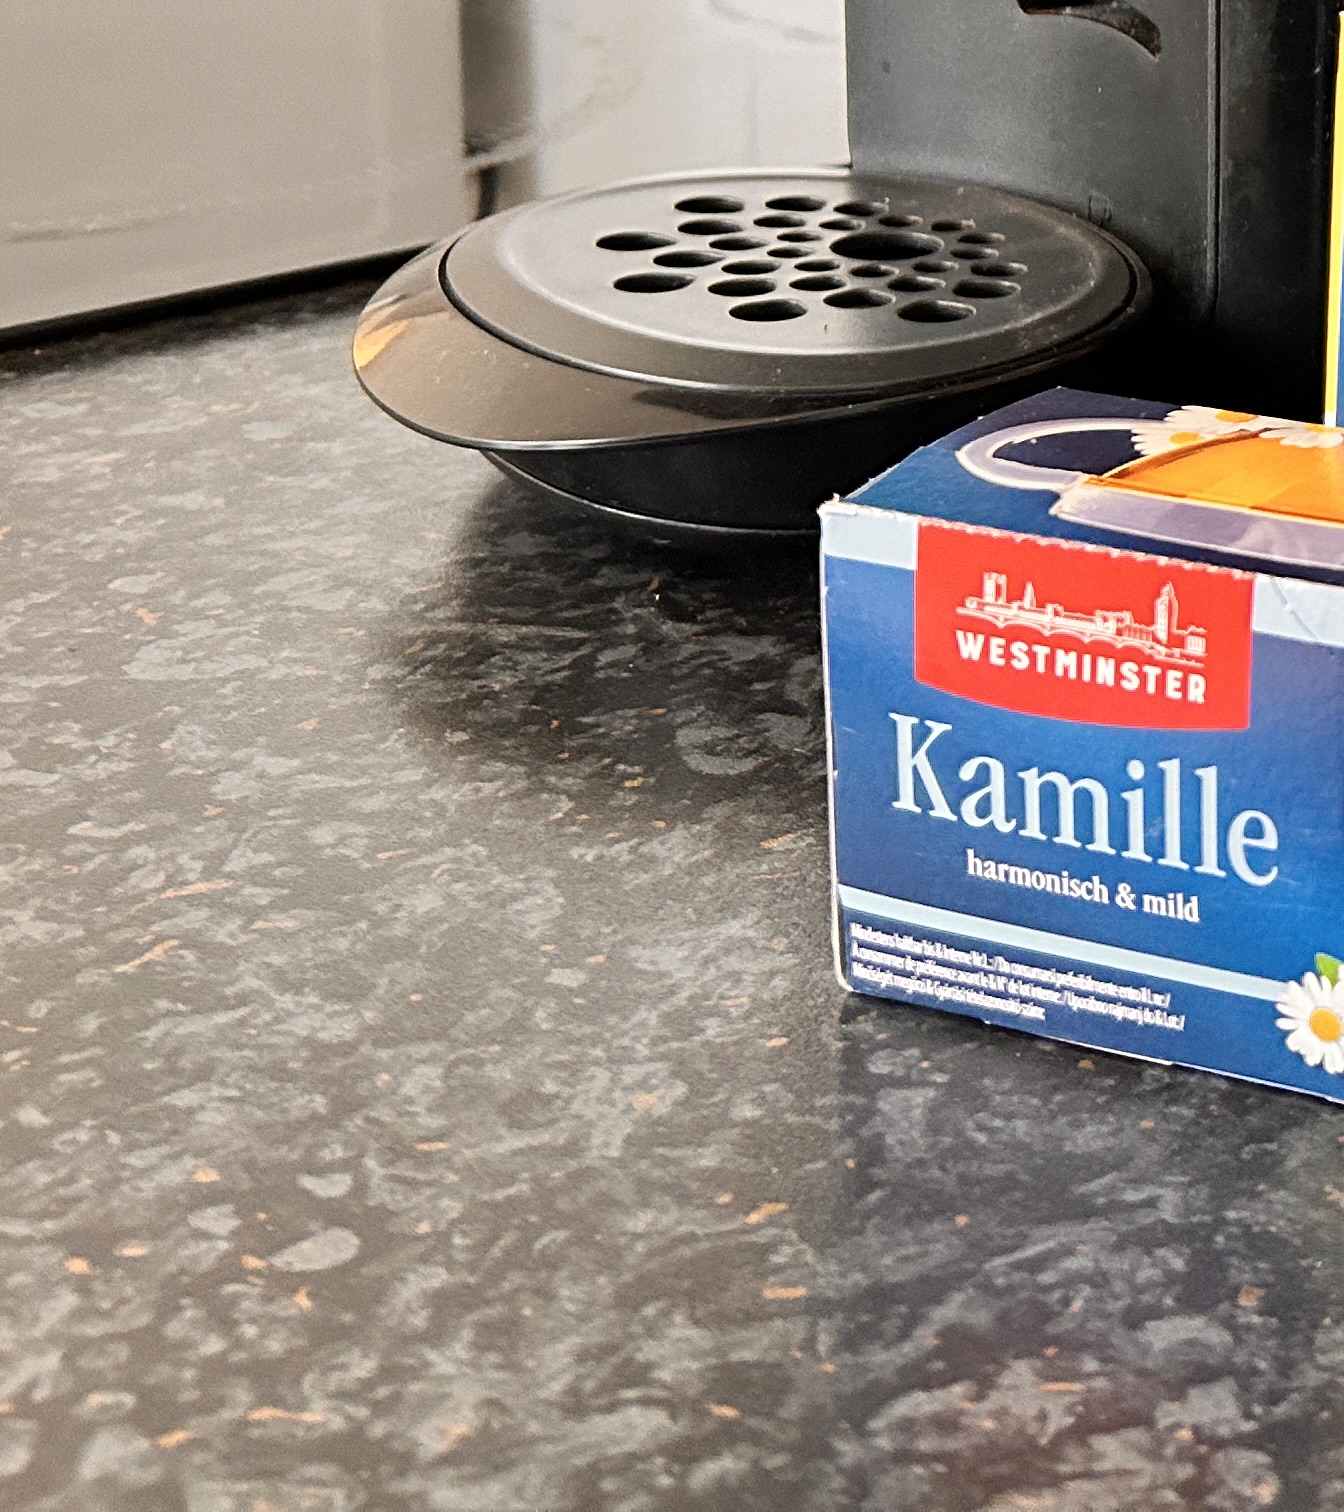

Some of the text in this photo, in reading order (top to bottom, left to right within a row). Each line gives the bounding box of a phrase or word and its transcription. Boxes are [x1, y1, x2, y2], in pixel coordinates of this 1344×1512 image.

[955, 630, 1206, 705] WESTMINSTER
[888, 712, 1279, 886] Kamille
[966, 849, 1201, 924] harmonisch & mild
